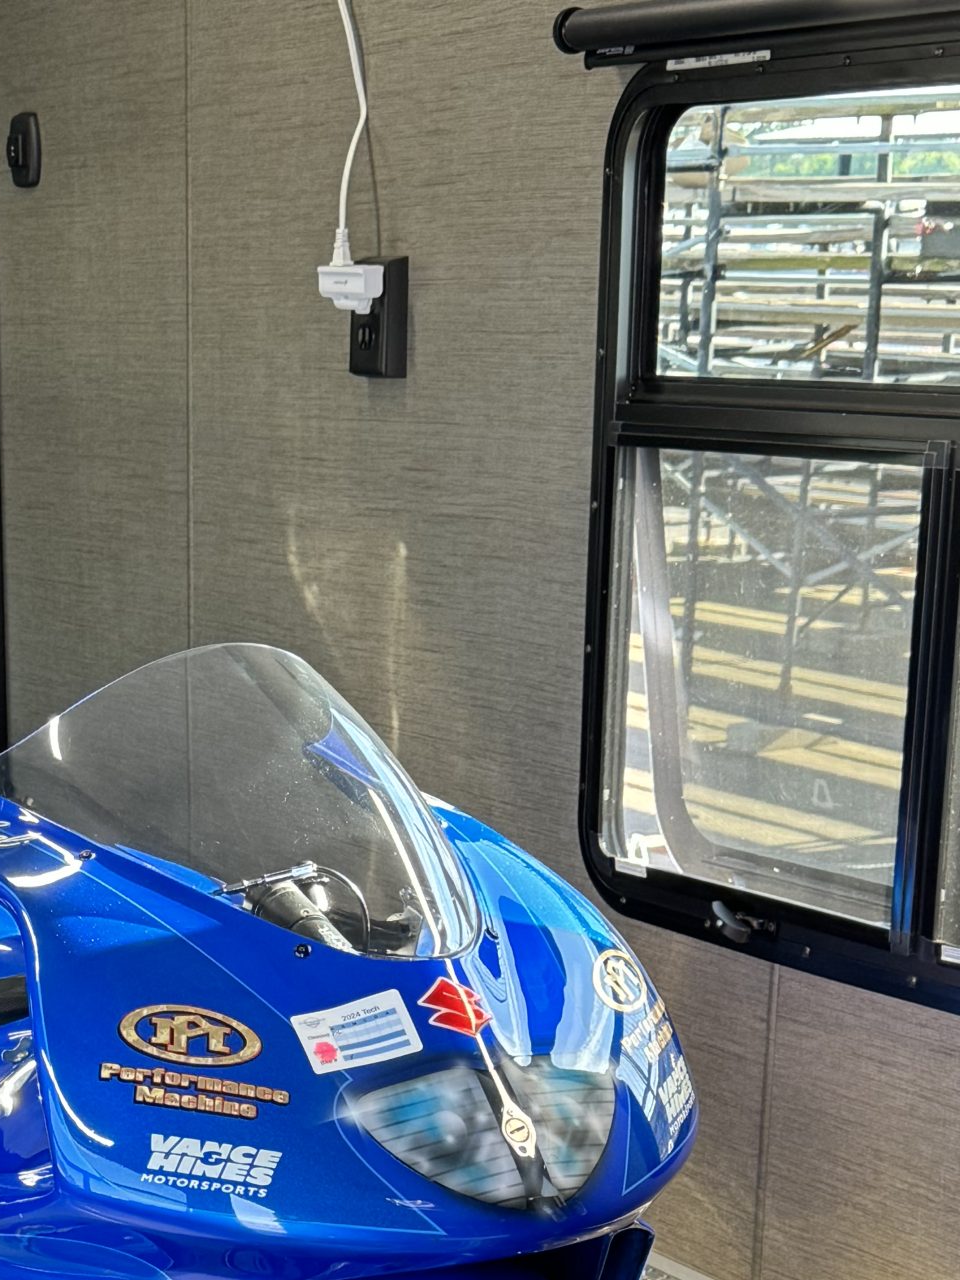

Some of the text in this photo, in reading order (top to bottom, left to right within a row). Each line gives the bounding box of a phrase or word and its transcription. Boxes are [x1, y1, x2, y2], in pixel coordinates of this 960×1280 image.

[341, 1011, 361, 1022] 2024
[361, 1005, 380, 1016] Tech
[100, 1062, 290, 1104] Performance
[134, 1085, 258, 1119] Machine
[150, 1133, 283, 1169] VANCE
[141, 1173, 268, 1198] MOTORSPORTS
[146, 1152, 276, 1186] HINES
